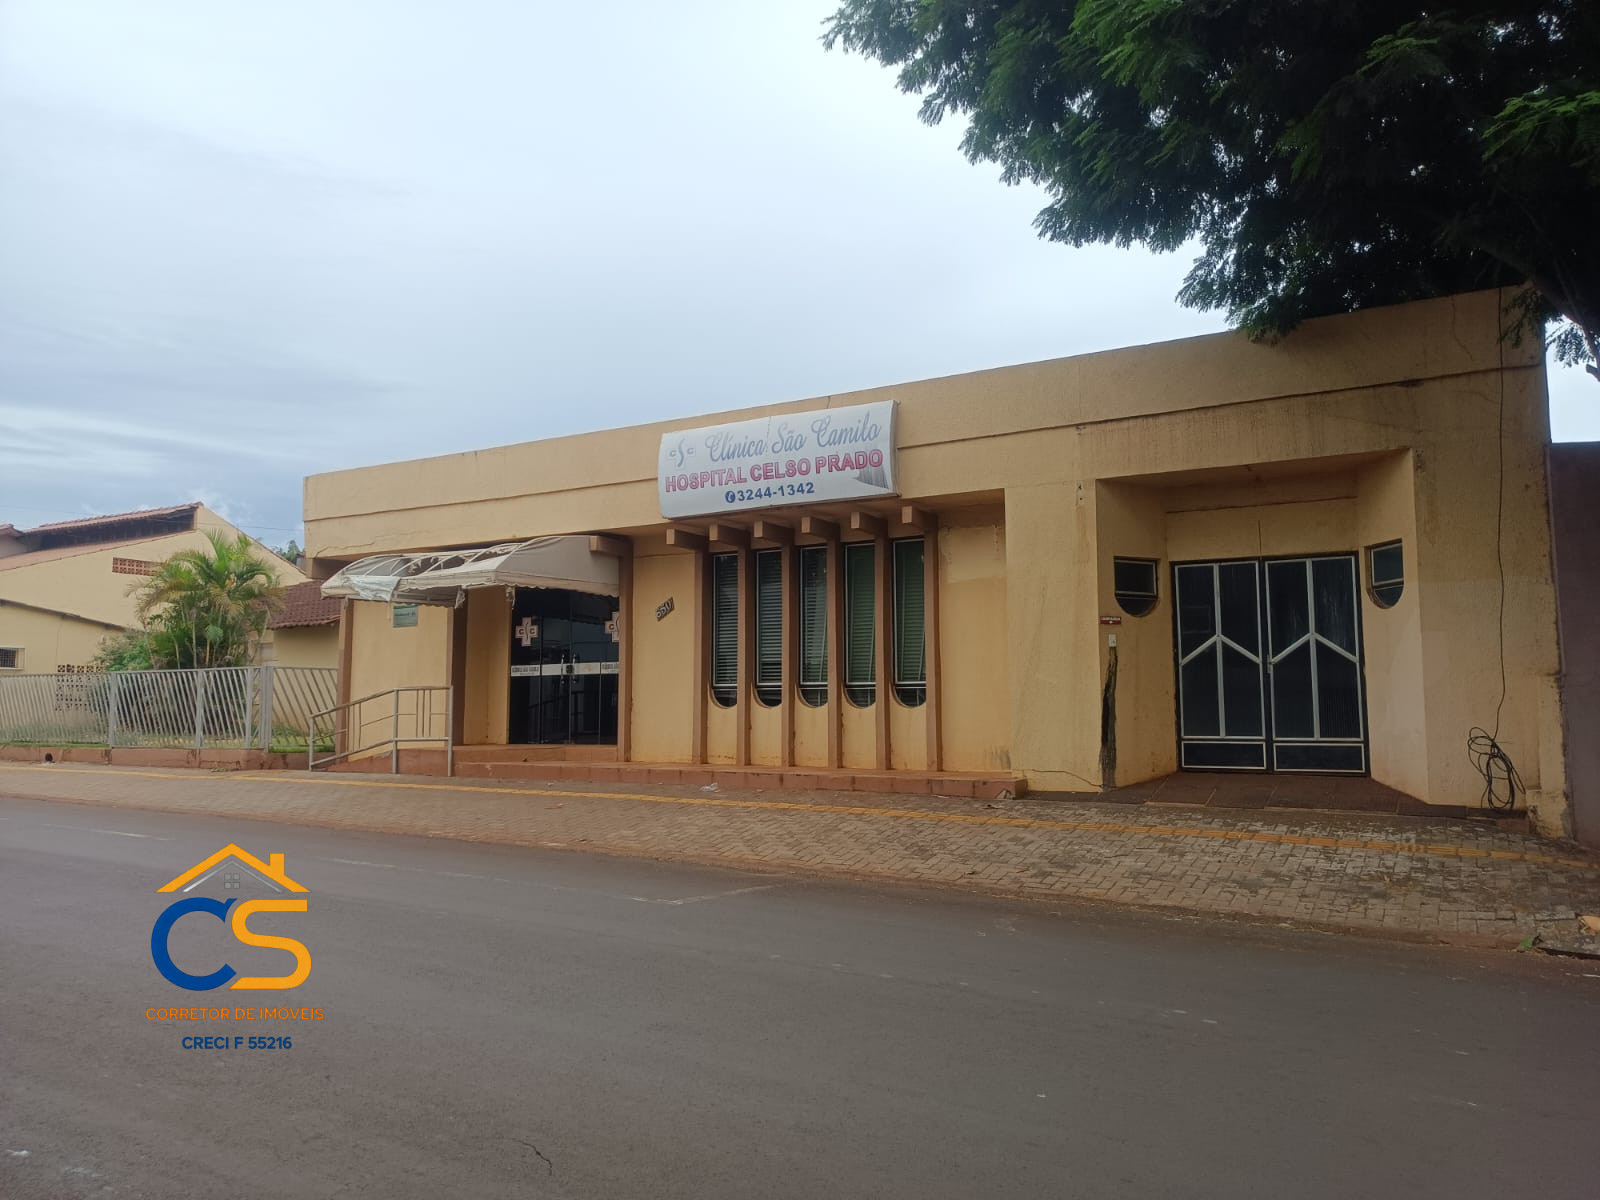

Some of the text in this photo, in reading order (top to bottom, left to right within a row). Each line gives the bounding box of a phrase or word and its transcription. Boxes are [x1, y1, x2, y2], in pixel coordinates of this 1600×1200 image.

[704, 410, 882, 462] Clínica São Camilo
[664, 449, 884, 493] HOSPITAL CELSO PRADO
[737, 481, 816, 501] 3244-1342
